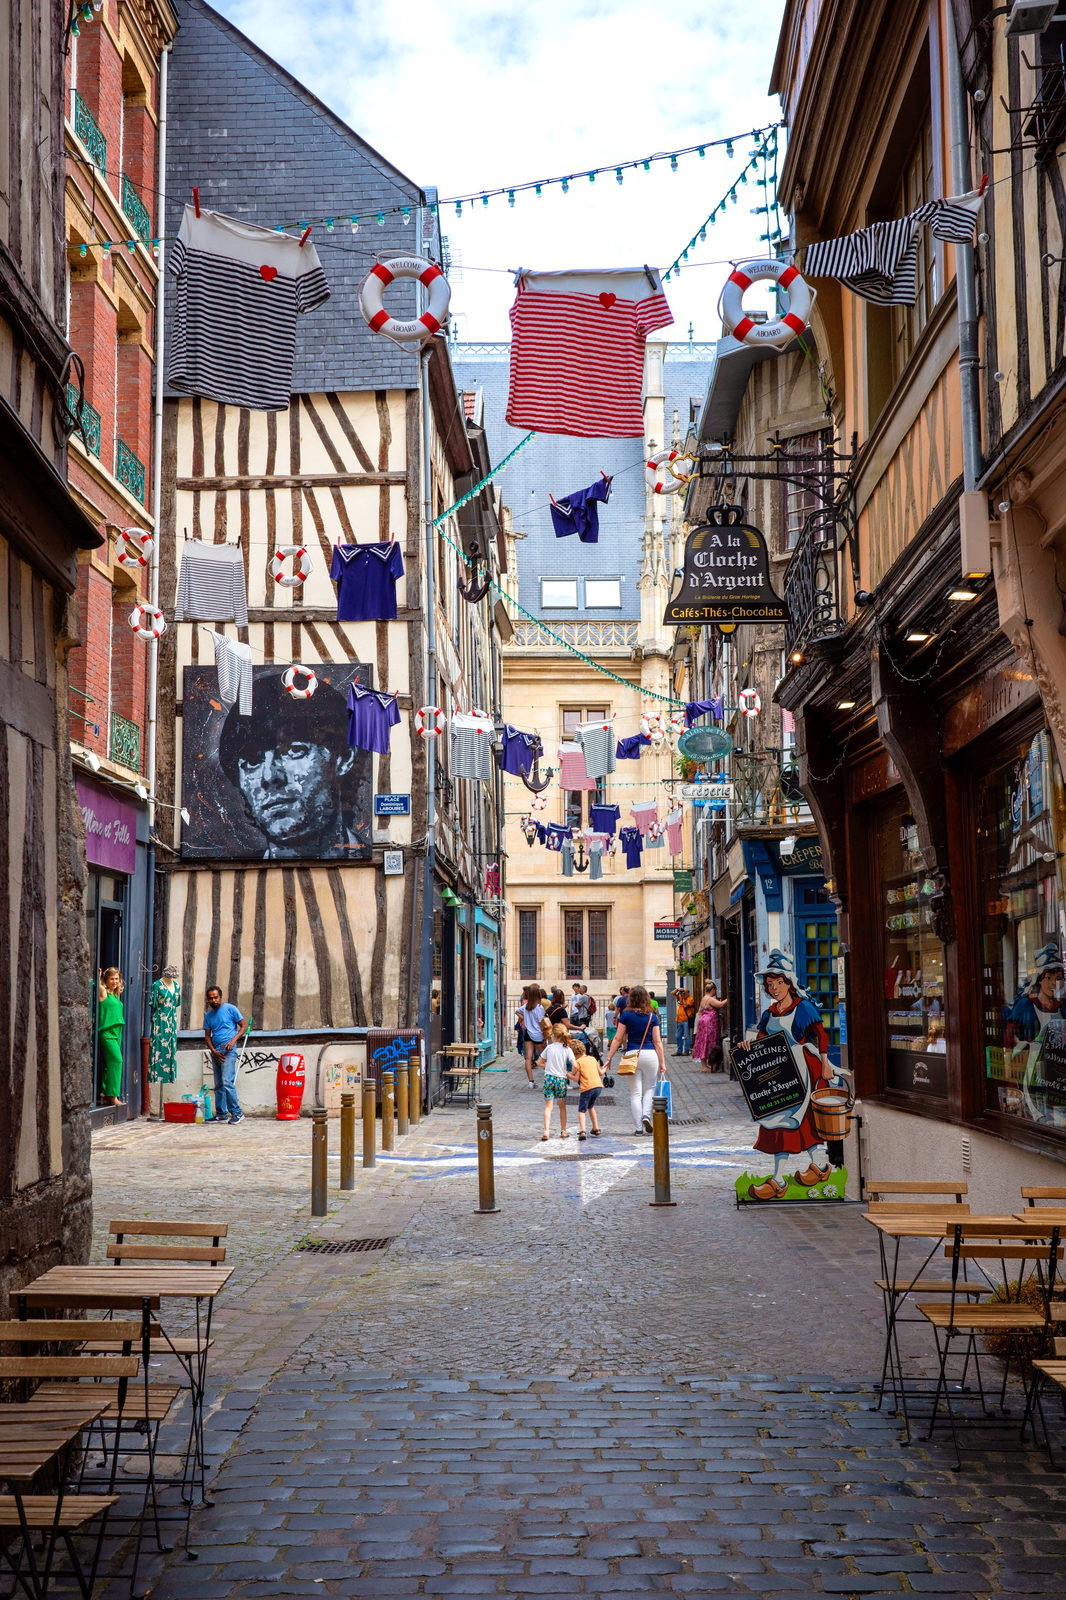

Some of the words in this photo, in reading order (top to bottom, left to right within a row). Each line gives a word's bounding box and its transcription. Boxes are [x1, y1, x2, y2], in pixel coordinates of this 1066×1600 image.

[389, 261, 422, 271] WELCOME
[747, 264, 780, 274] WELCOME
[391, 324, 417, 332] ABOARD
[755, 328, 781, 337] ABOARD
[710, 534, 723, 548] A
[727, 534, 741, 547] la
[693, 551, 758, 571] Cloche
[689, 571, 765, 591] d'Argent
[671, 606, 783, 618] Cafés-Thés-Chocolats
[682, 727, 704, 742] SALON
[680, 785, 731, 798] Crêperie
[81, 806, 103, 836] Mère
[103, 821, 112, 839] et
[113, 819, 131, 845] Fille
[764, 878, 774, 890] 12
[737, 1045, 787, 1069] MADELEINES
[741, 1055, 788, 1081] Jeannette
[749, 1088, 772, 1101] Cloche
[772, 1077, 799, 1092] d'Argent
